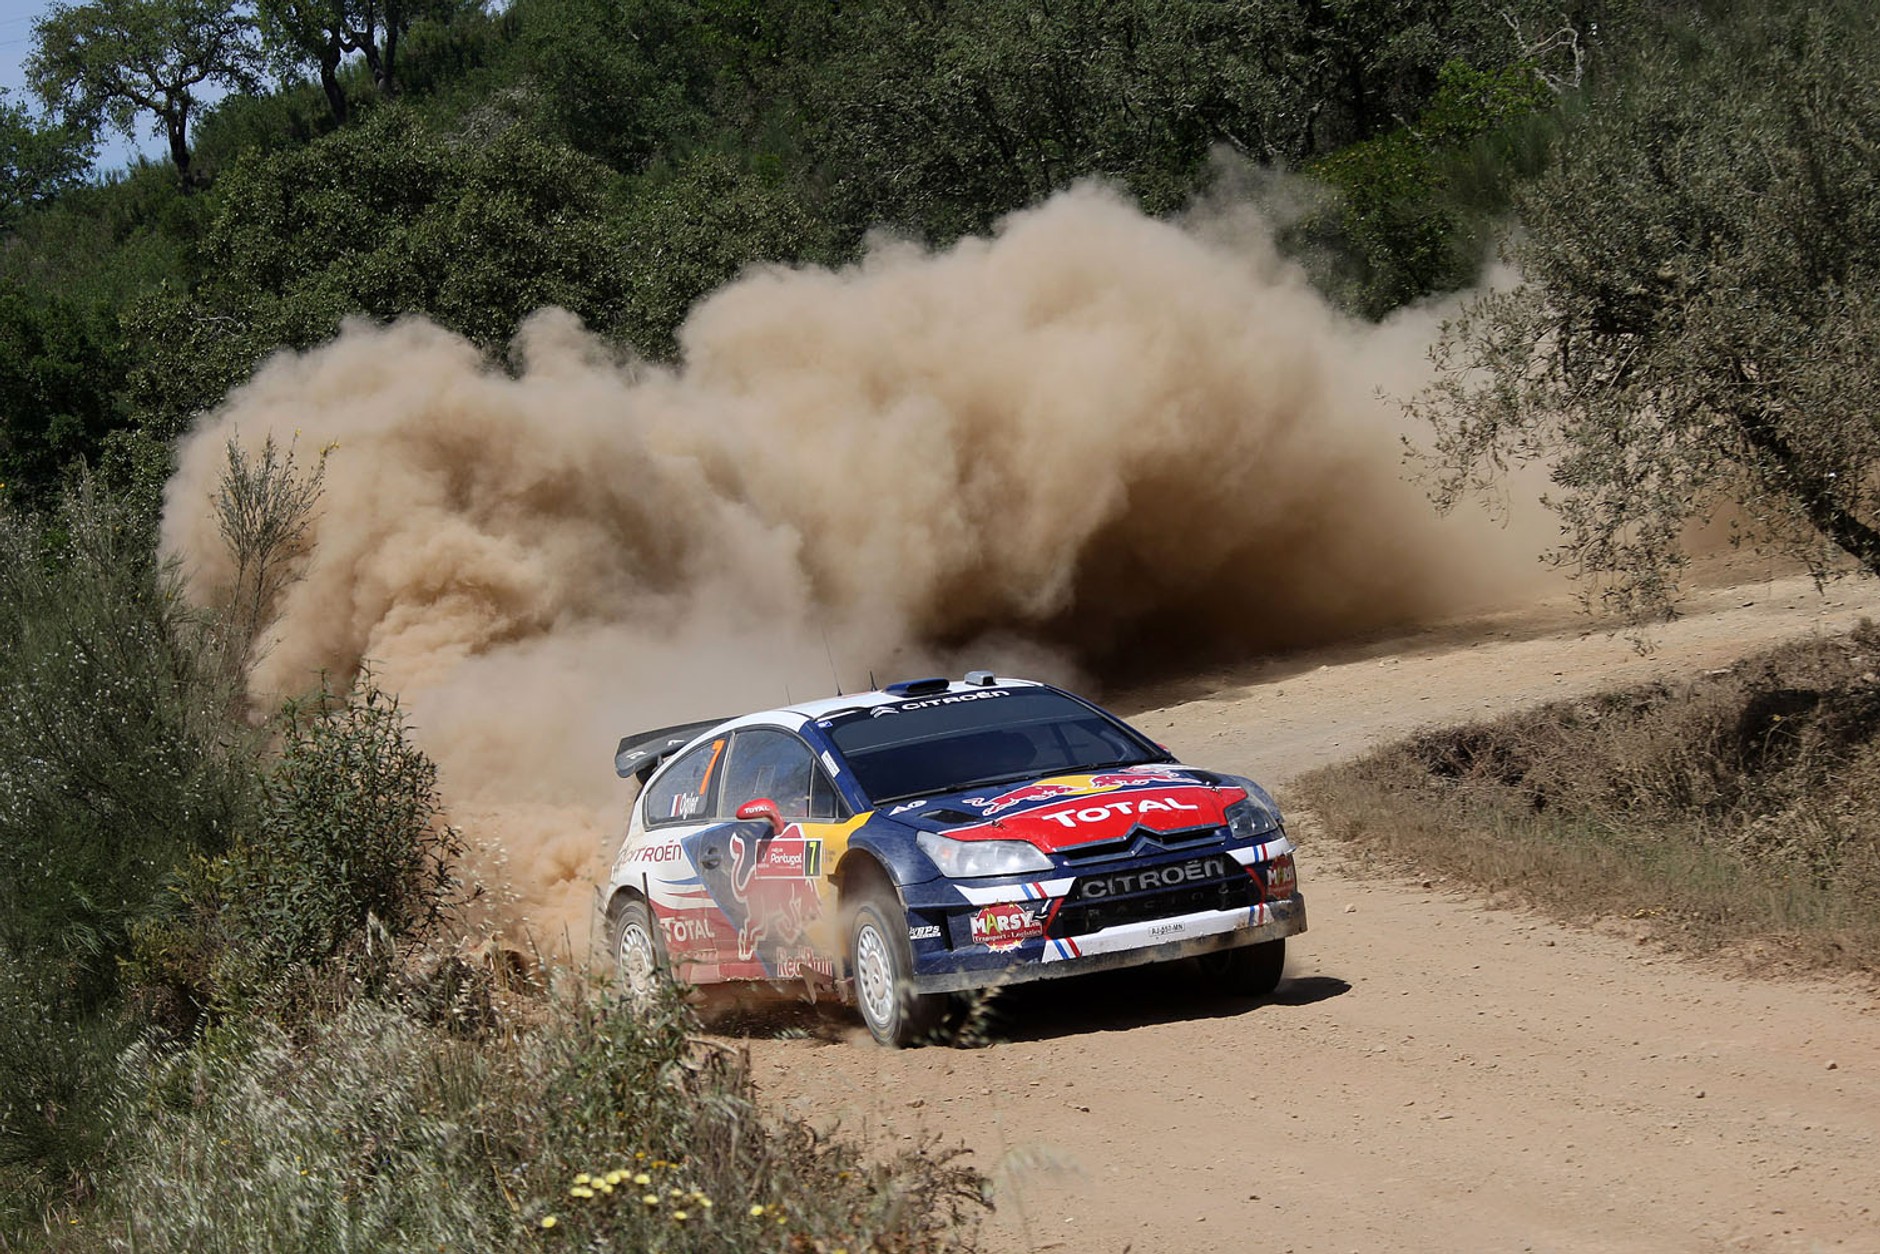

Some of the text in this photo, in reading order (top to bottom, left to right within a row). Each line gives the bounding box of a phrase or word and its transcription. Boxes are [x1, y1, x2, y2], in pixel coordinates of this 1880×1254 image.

[700, 738, 726, 796] 7
[744, 805, 770, 814] TOTAL
[1042, 797, 1198, 828] TOTAL
[770, 852, 802, 866] Portugal
[809, 841, 817, 875] 7
[659, 916, 715, 943] TOTAL
